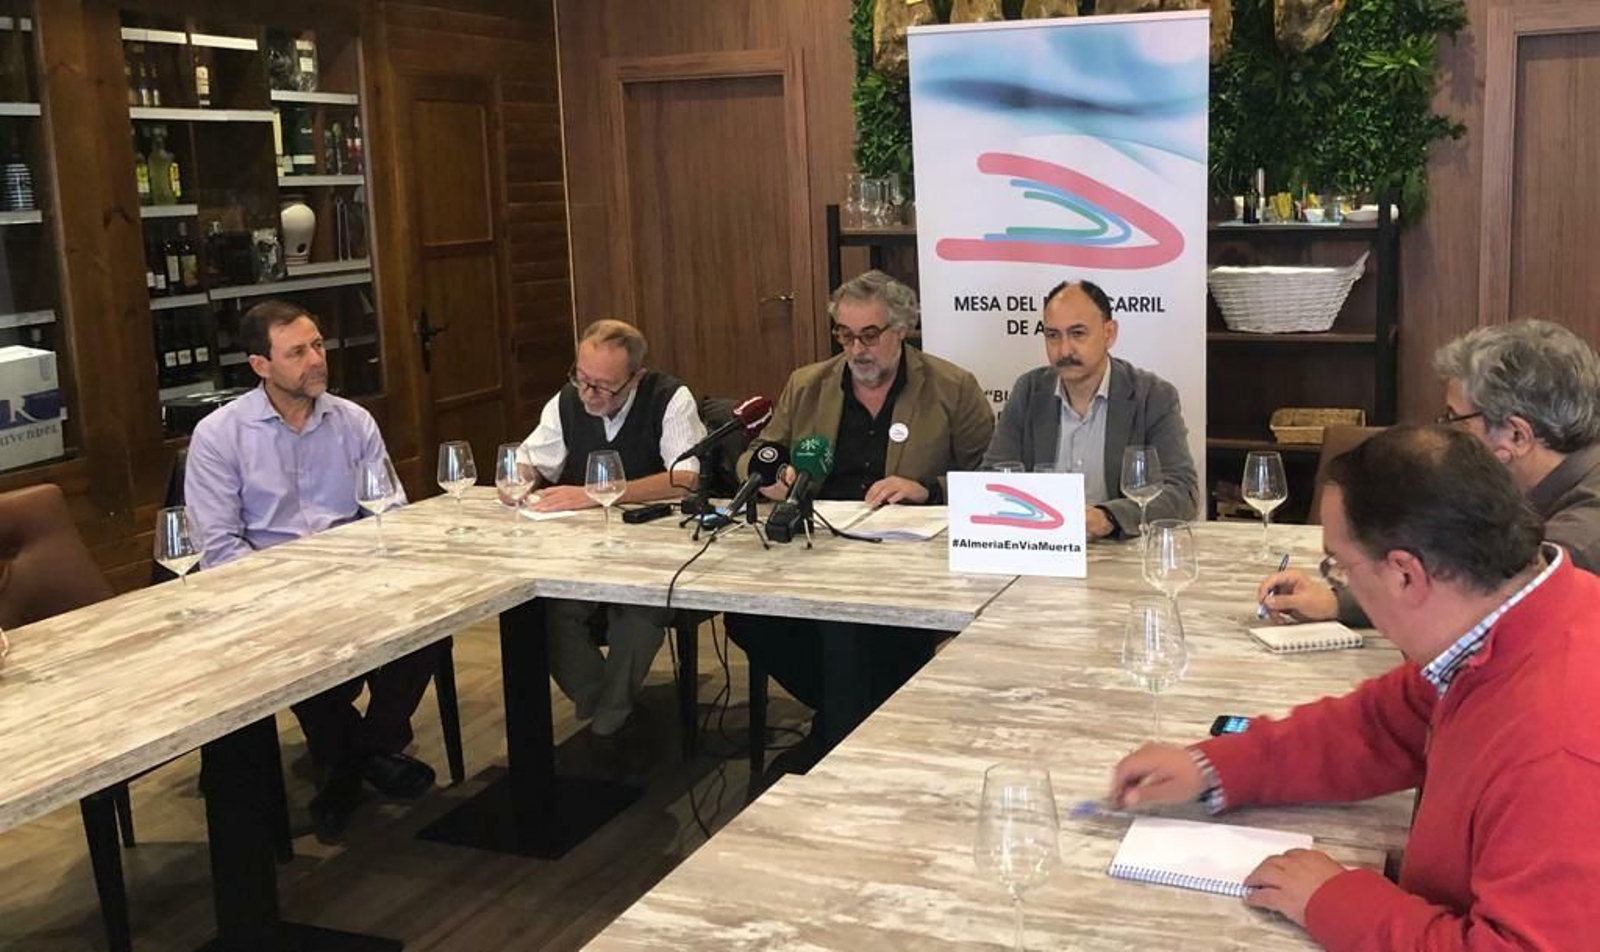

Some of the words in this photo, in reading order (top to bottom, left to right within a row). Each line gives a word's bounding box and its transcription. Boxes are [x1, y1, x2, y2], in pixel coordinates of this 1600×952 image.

[954, 296, 1001, 311] MESA
[1006, 296, 1037, 312] DEL
[1007, 320, 1028, 335] DE
